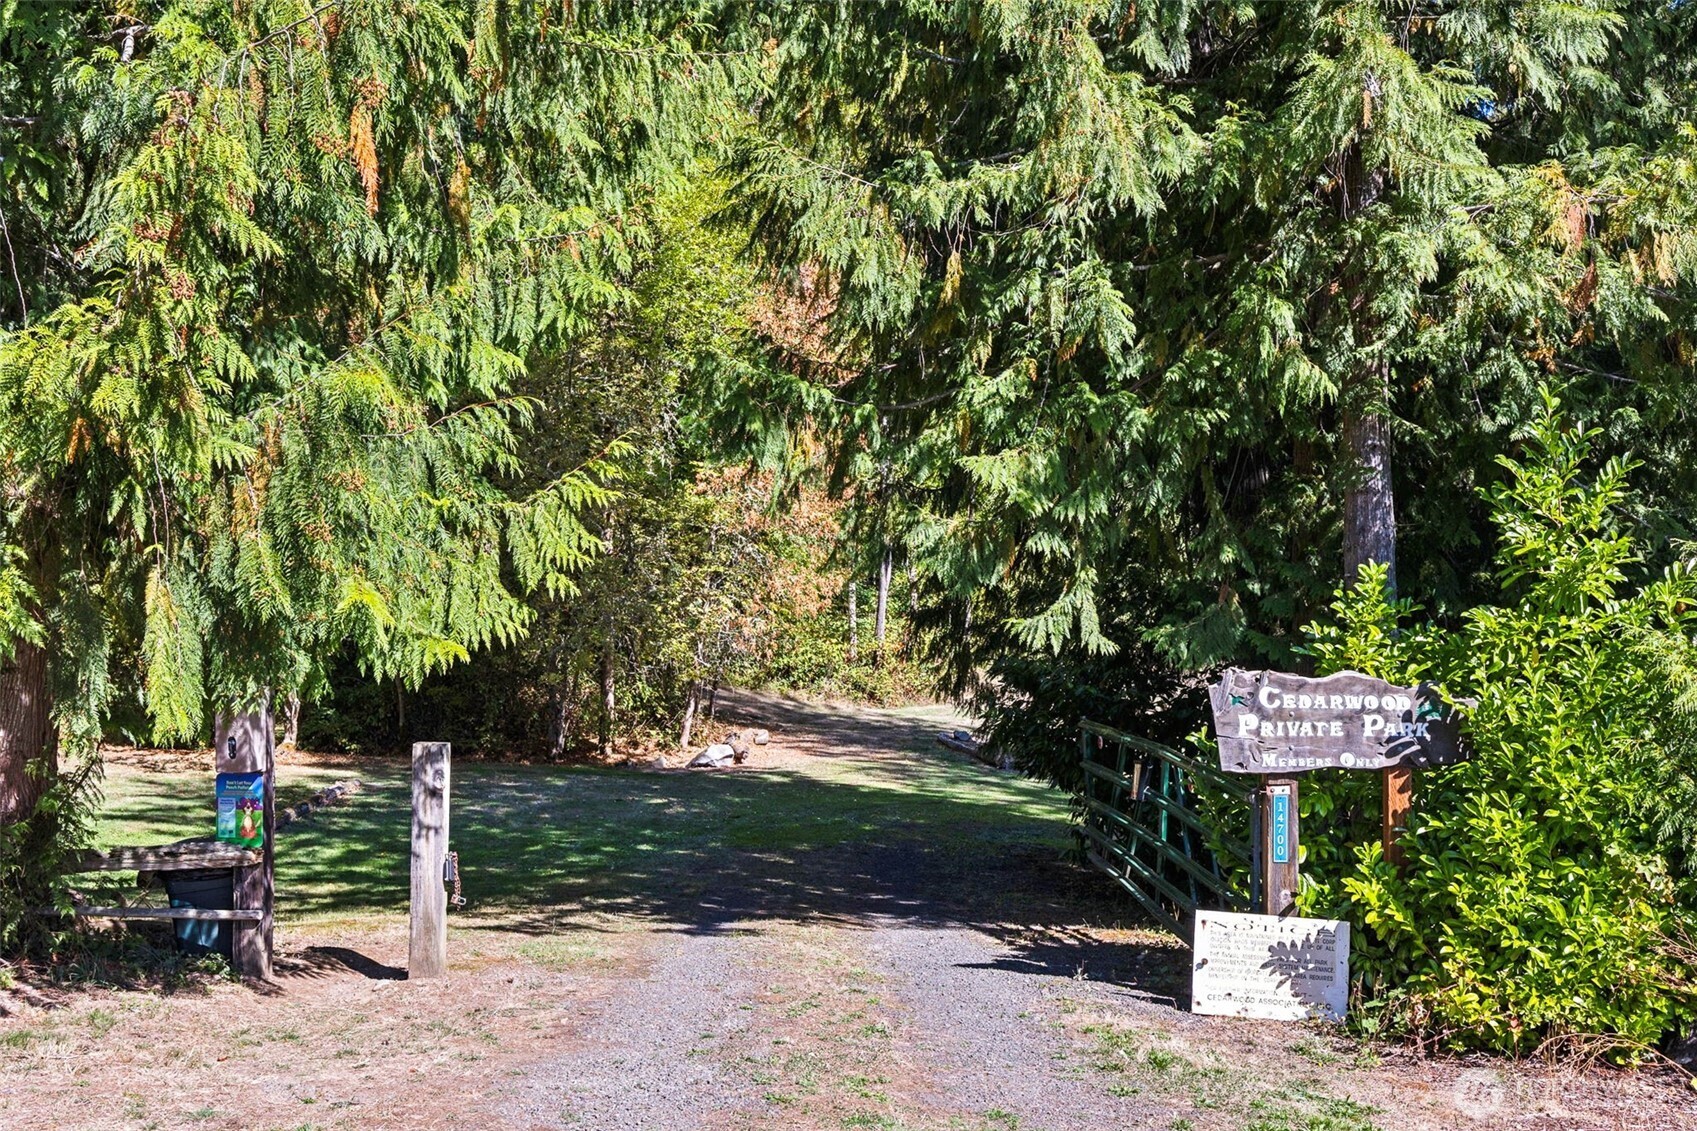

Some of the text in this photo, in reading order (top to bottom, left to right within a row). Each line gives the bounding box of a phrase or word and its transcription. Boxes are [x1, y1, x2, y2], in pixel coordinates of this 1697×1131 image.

[1259, 687, 1411, 711] CEDARWOOD
[1238, 713, 1429, 738] PRIVATE PARK
[1262, 752, 1380, 768] MEMBERS ONLY
[1276, 802, 1284, 856] 14700
